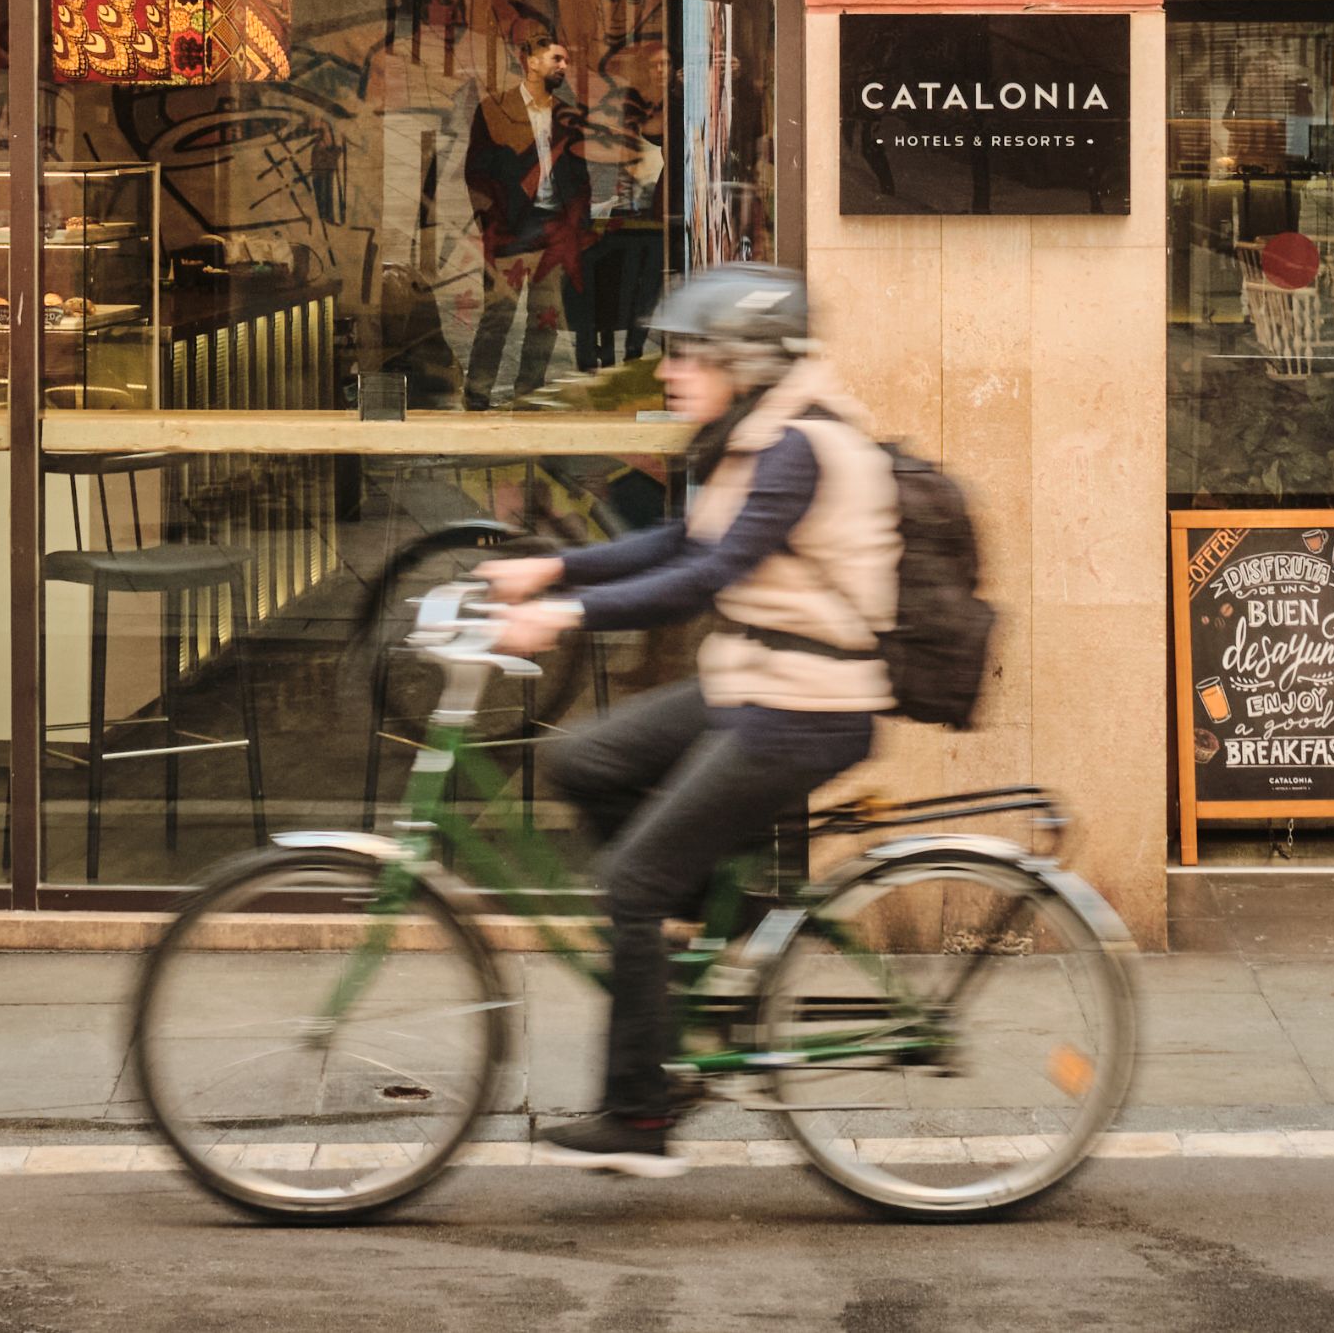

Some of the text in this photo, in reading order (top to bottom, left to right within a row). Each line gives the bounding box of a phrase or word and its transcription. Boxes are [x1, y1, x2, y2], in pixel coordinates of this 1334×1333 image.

[861, 83, 1108, 109] CATALONIA
[895, 135, 1075, 147] HOTELS & RESORTS
[1223, 555, 1331, 592] DISFRUTA
[1259, 584, 1297, 595] DE UN
[1248, 600, 1319, 627] BUEN
[1247, 688, 1327, 716] ENJOY
[1235, 722, 1254, 736] a
[1269, 777, 1313, 785] CATALONIA
